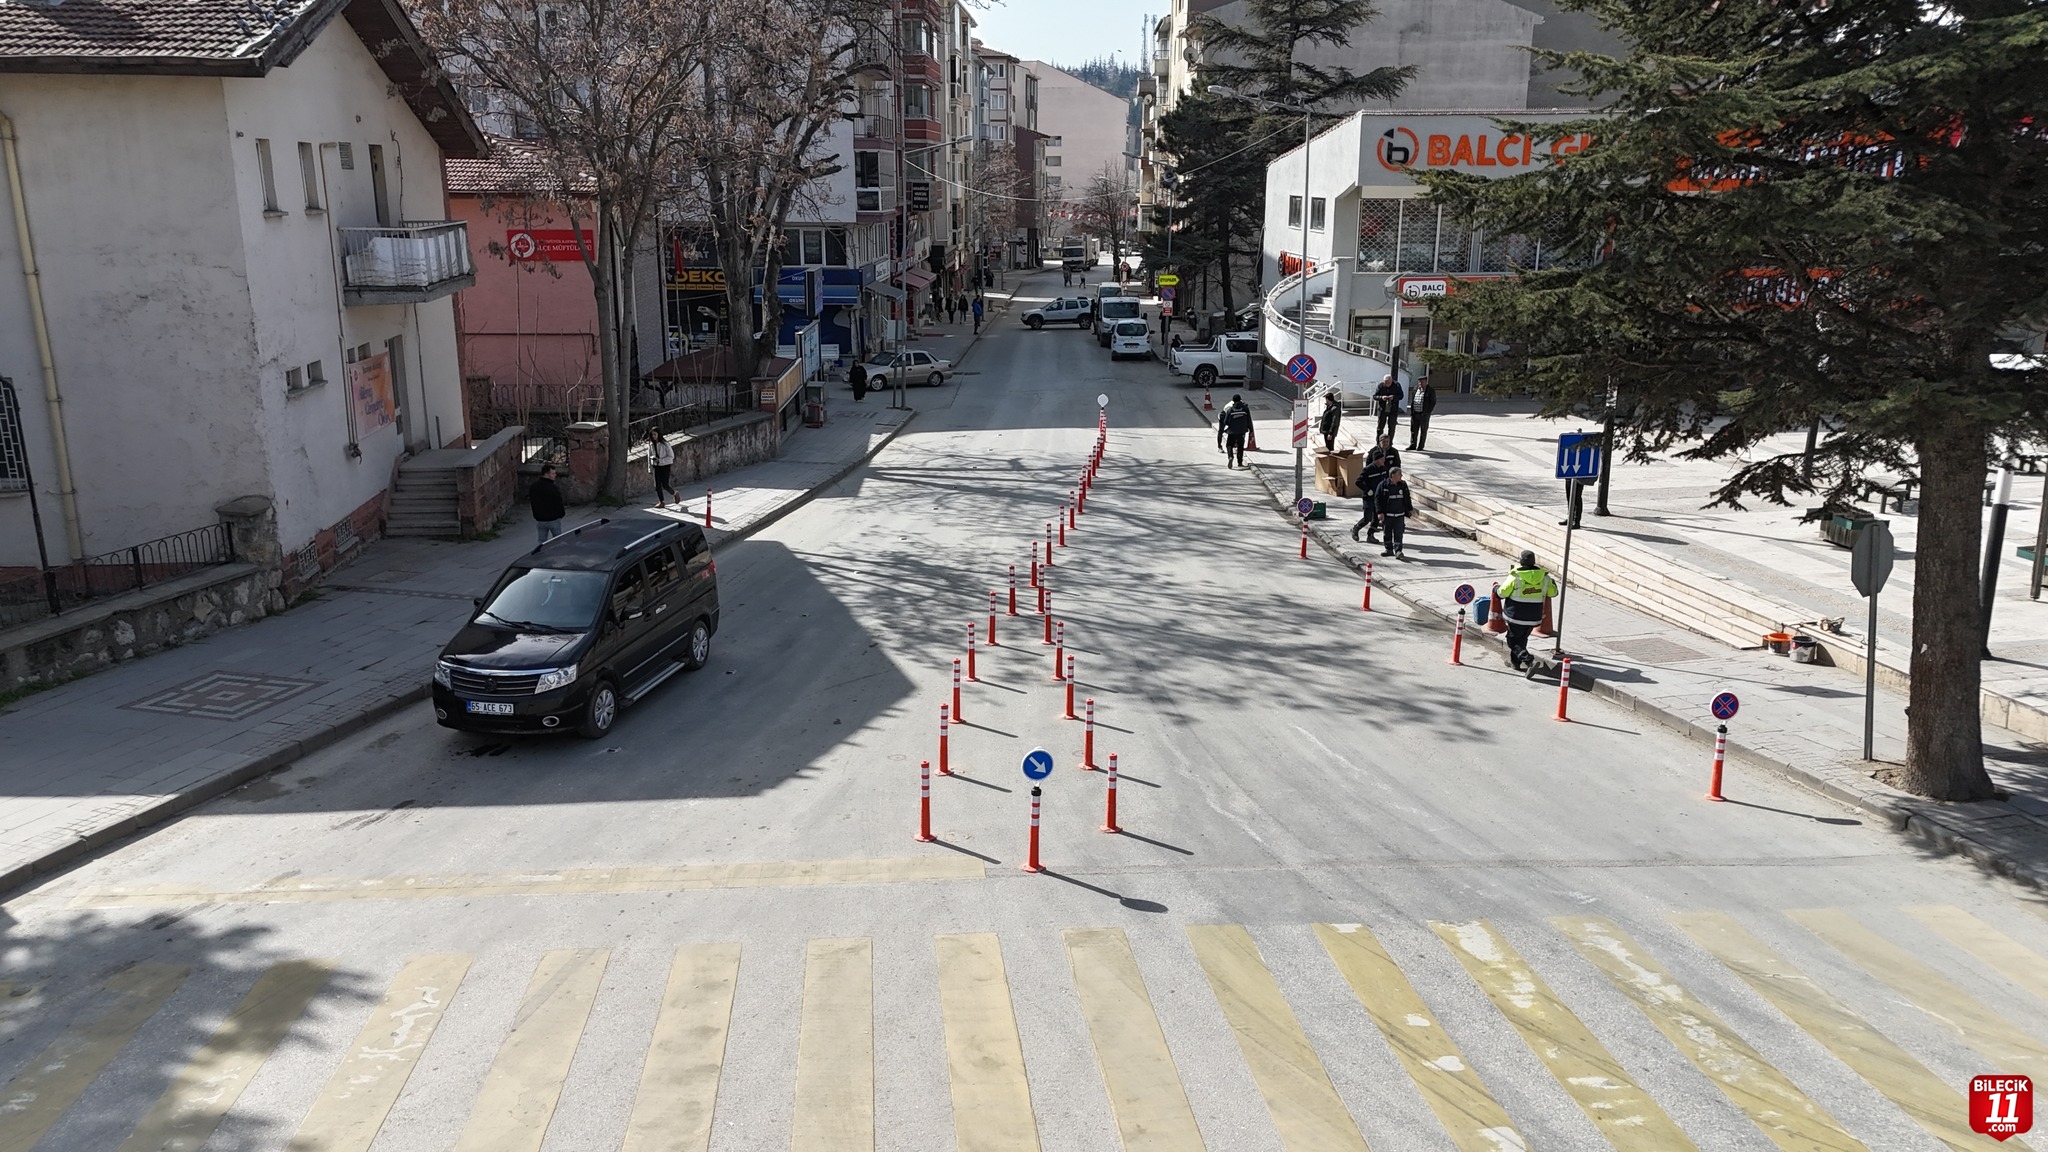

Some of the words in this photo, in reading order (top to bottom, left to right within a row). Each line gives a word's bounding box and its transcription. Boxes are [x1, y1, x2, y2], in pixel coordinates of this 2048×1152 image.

[1427, 134, 1533, 166] BALCI
[1422, 284, 1444, 292] BALCI
[471, 702, 480, 711] 65
[483, 703, 496, 712] ACE
[499, 704, 513, 713] 673
